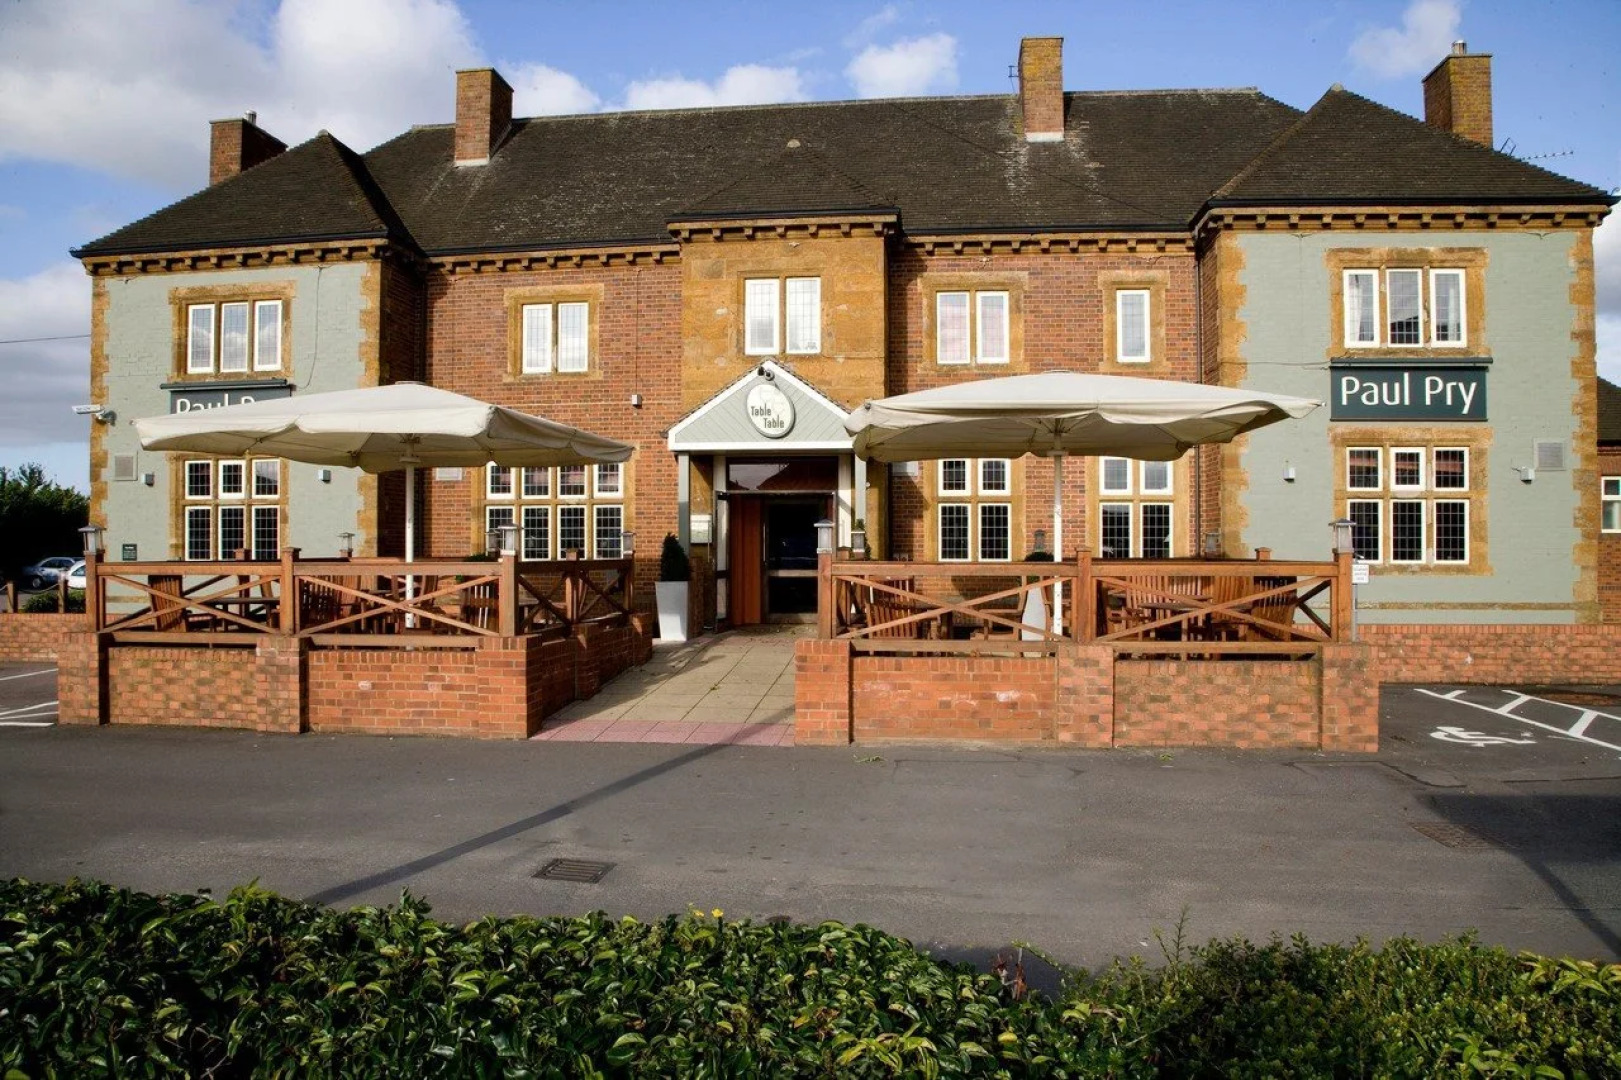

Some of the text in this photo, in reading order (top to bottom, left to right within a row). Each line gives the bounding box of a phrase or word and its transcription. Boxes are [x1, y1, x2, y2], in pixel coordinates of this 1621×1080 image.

[1341, 372, 1477, 415] Paul Pry
[751, 402, 772, 416] Table
[763, 414, 785, 429] Table
